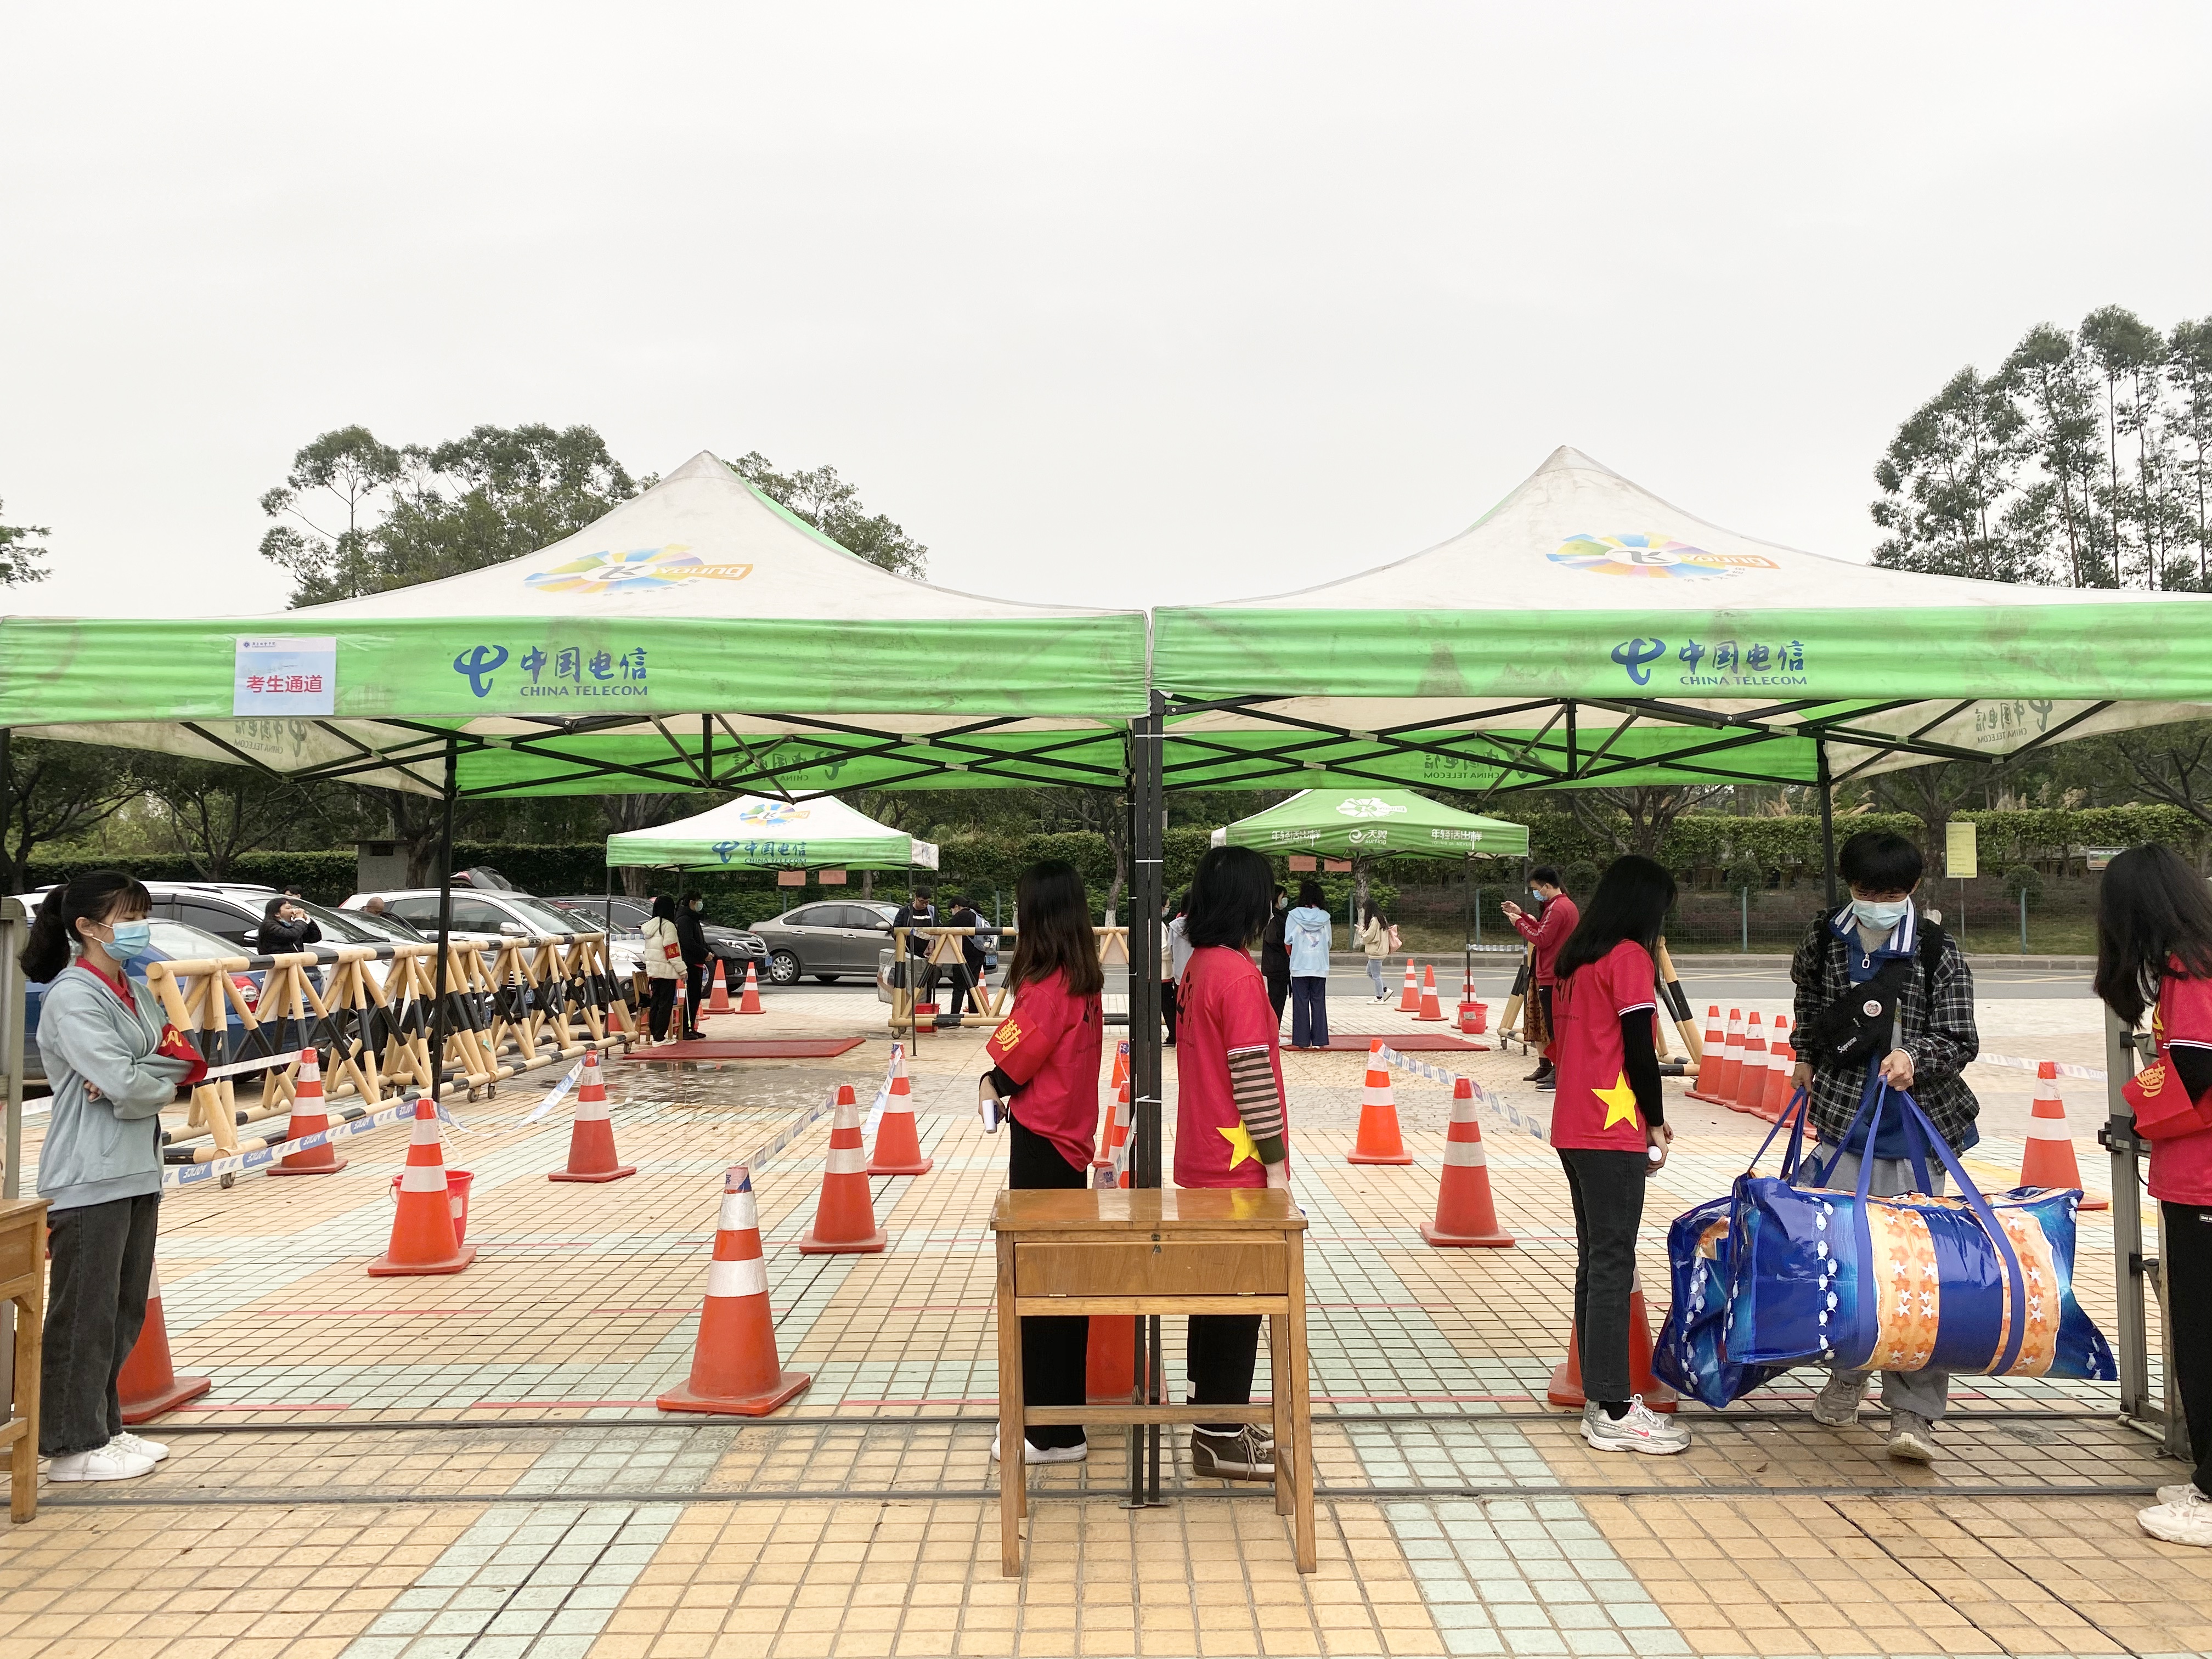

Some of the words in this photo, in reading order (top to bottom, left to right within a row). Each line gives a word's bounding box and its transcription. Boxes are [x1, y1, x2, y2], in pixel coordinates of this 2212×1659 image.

[520, 645, 648, 684] 中国电信
[1678, 638, 1804, 674] 中国电信
[246, 675, 323, 693] 考生通道
[1680, 676, 1732, 686] CHINA
[1735, 676, 1807, 685] TELECOM
[520, 686, 569, 697] CHINA
[575, 685, 648, 696] TELECOM
[1271, 829, 1321, 848] 年轻活出样
[1367, 830, 1387, 839] 天翼
[1431, 829, 1482, 850] 年轻活出样
[744, 840, 807, 857] 中国电信
[994, 1018, 1022, 1052] 勤
[1837, 1036, 1858, 1053] Supreme
[2136, 1063, 2165, 1098] 勤
